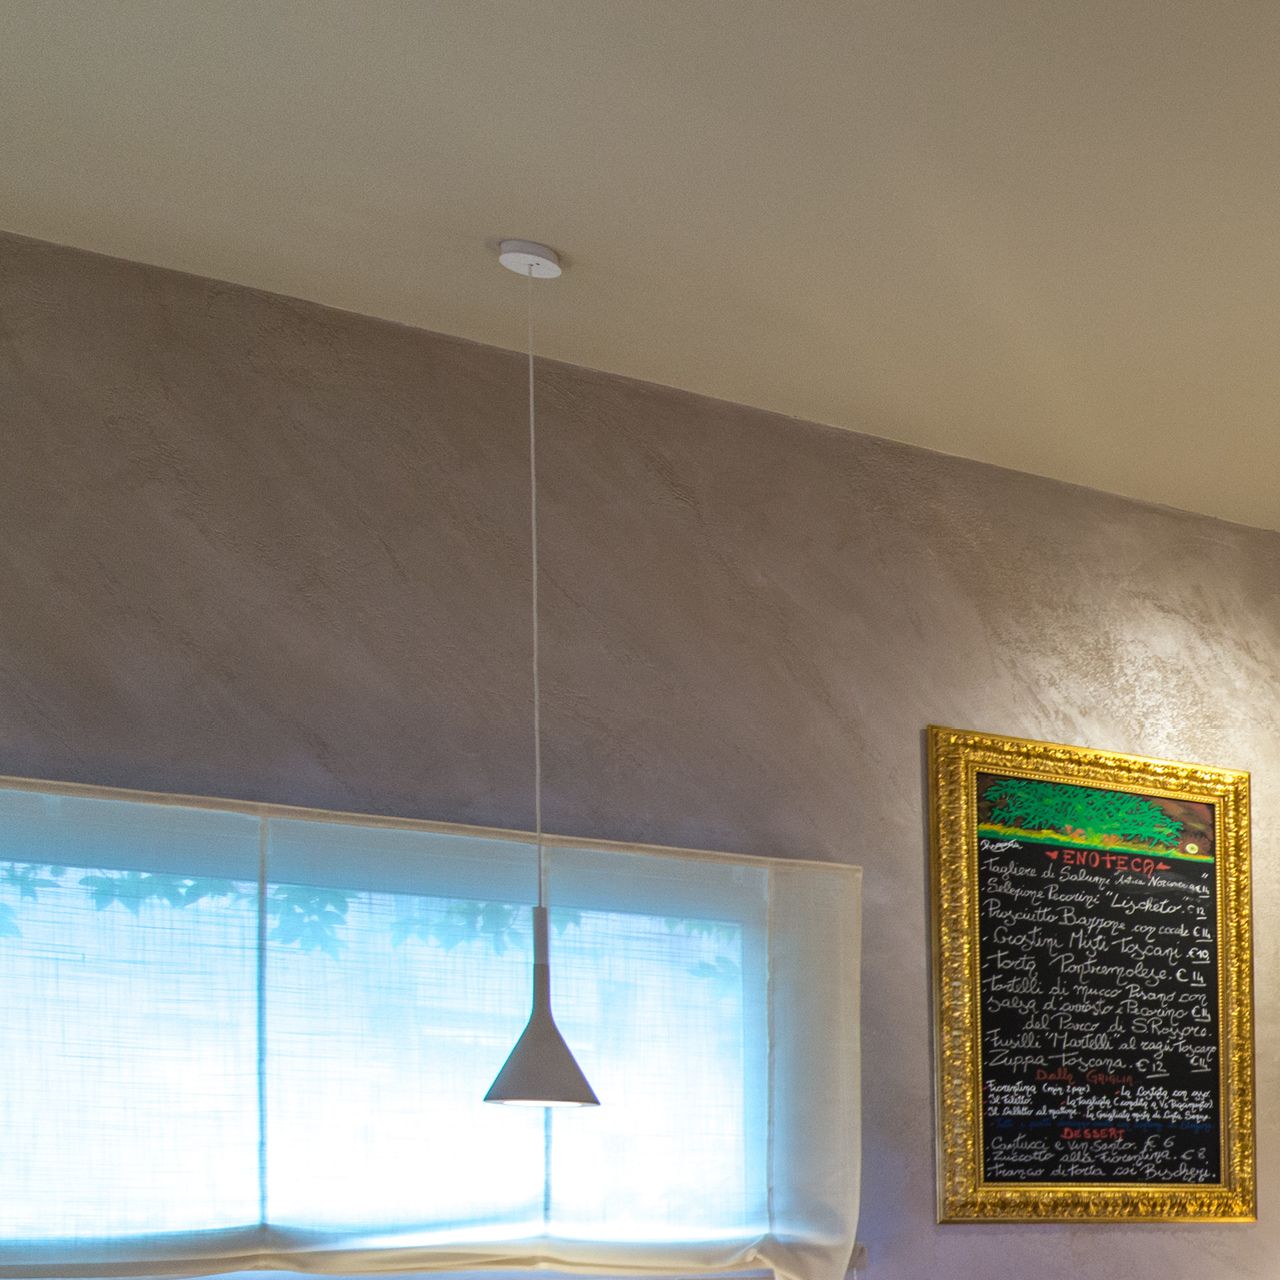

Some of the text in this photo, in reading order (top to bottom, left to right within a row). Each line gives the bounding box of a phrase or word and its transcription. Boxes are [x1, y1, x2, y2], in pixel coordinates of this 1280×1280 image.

[983, 857, 1037, 880] Tagliere
[1041, 863, 1055, 878] di
[1059, 866, 1110, 890] Salumi
[1062, 850, 1154, 879] ENOTECA
[987, 877, 1044, 906] Selezione
[1044, 883, 1100, 909] Pecorini
[982, 897, 1058, 926] Prosciutto
[1132, 924, 1156, 942] con
[993, 926, 1064, 957] Crostini
[1069, 929, 1109, 957] Misti
[987, 950, 1038, 979] Torta
[982, 974, 1044, 994] Tortelli
[1048, 976, 1069, 995] di
[1125, 983, 1177, 1008] Pisano
[1178, 993, 1209, 1007] con
[1022, 1013, 1051, 1030] del
[1050, 1012, 1100, 1031] Parco
[1107, 1015, 1126, 1033] di
[1120, 999, 1188, 1026] Pecorino
[985, 1028, 1042, 1049] Fusilli
[1118, 1036, 1137, 1050] al
[1173, 1039, 1217, 1062] Toscano
[988, 1049, 1048, 1074] Zuppa
[1035, 1066, 1075, 1085] Dalla
[986, 1080, 1037, 1097] Fiorentina
[1121, 1085, 1132, 1098] La
[1136, 1086, 1168, 1100] Costata
[1172, 1090, 1188, 1101] con
[987, 1094, 1000, 1104] Il
[1066, 1096, 1077, 1107] La
[1076, 1096, 1112, 1110] Tagliata
[987, 1106, 1000, 1116] Il
[1036, 1105, 1047, 1116] al
[1086, 1110, 1096, 1121] La
[1096, 1109, 1132, 1122] Grigliata
[1131, 1111, 1151, 1122] mista
[1152, 1111, 1161, 1119] di
[1061, 1126, 1126, 1139] DESSERT
[991, 1133, 1049, 1153] Cantucci
[1055, 1141, 1064, 1151] e
[992, 1150, 1055, 1162] Zuccotto
[1060, 1151, 1095, 1163] alla
[1112, 1164, 1138, 1176] coi
